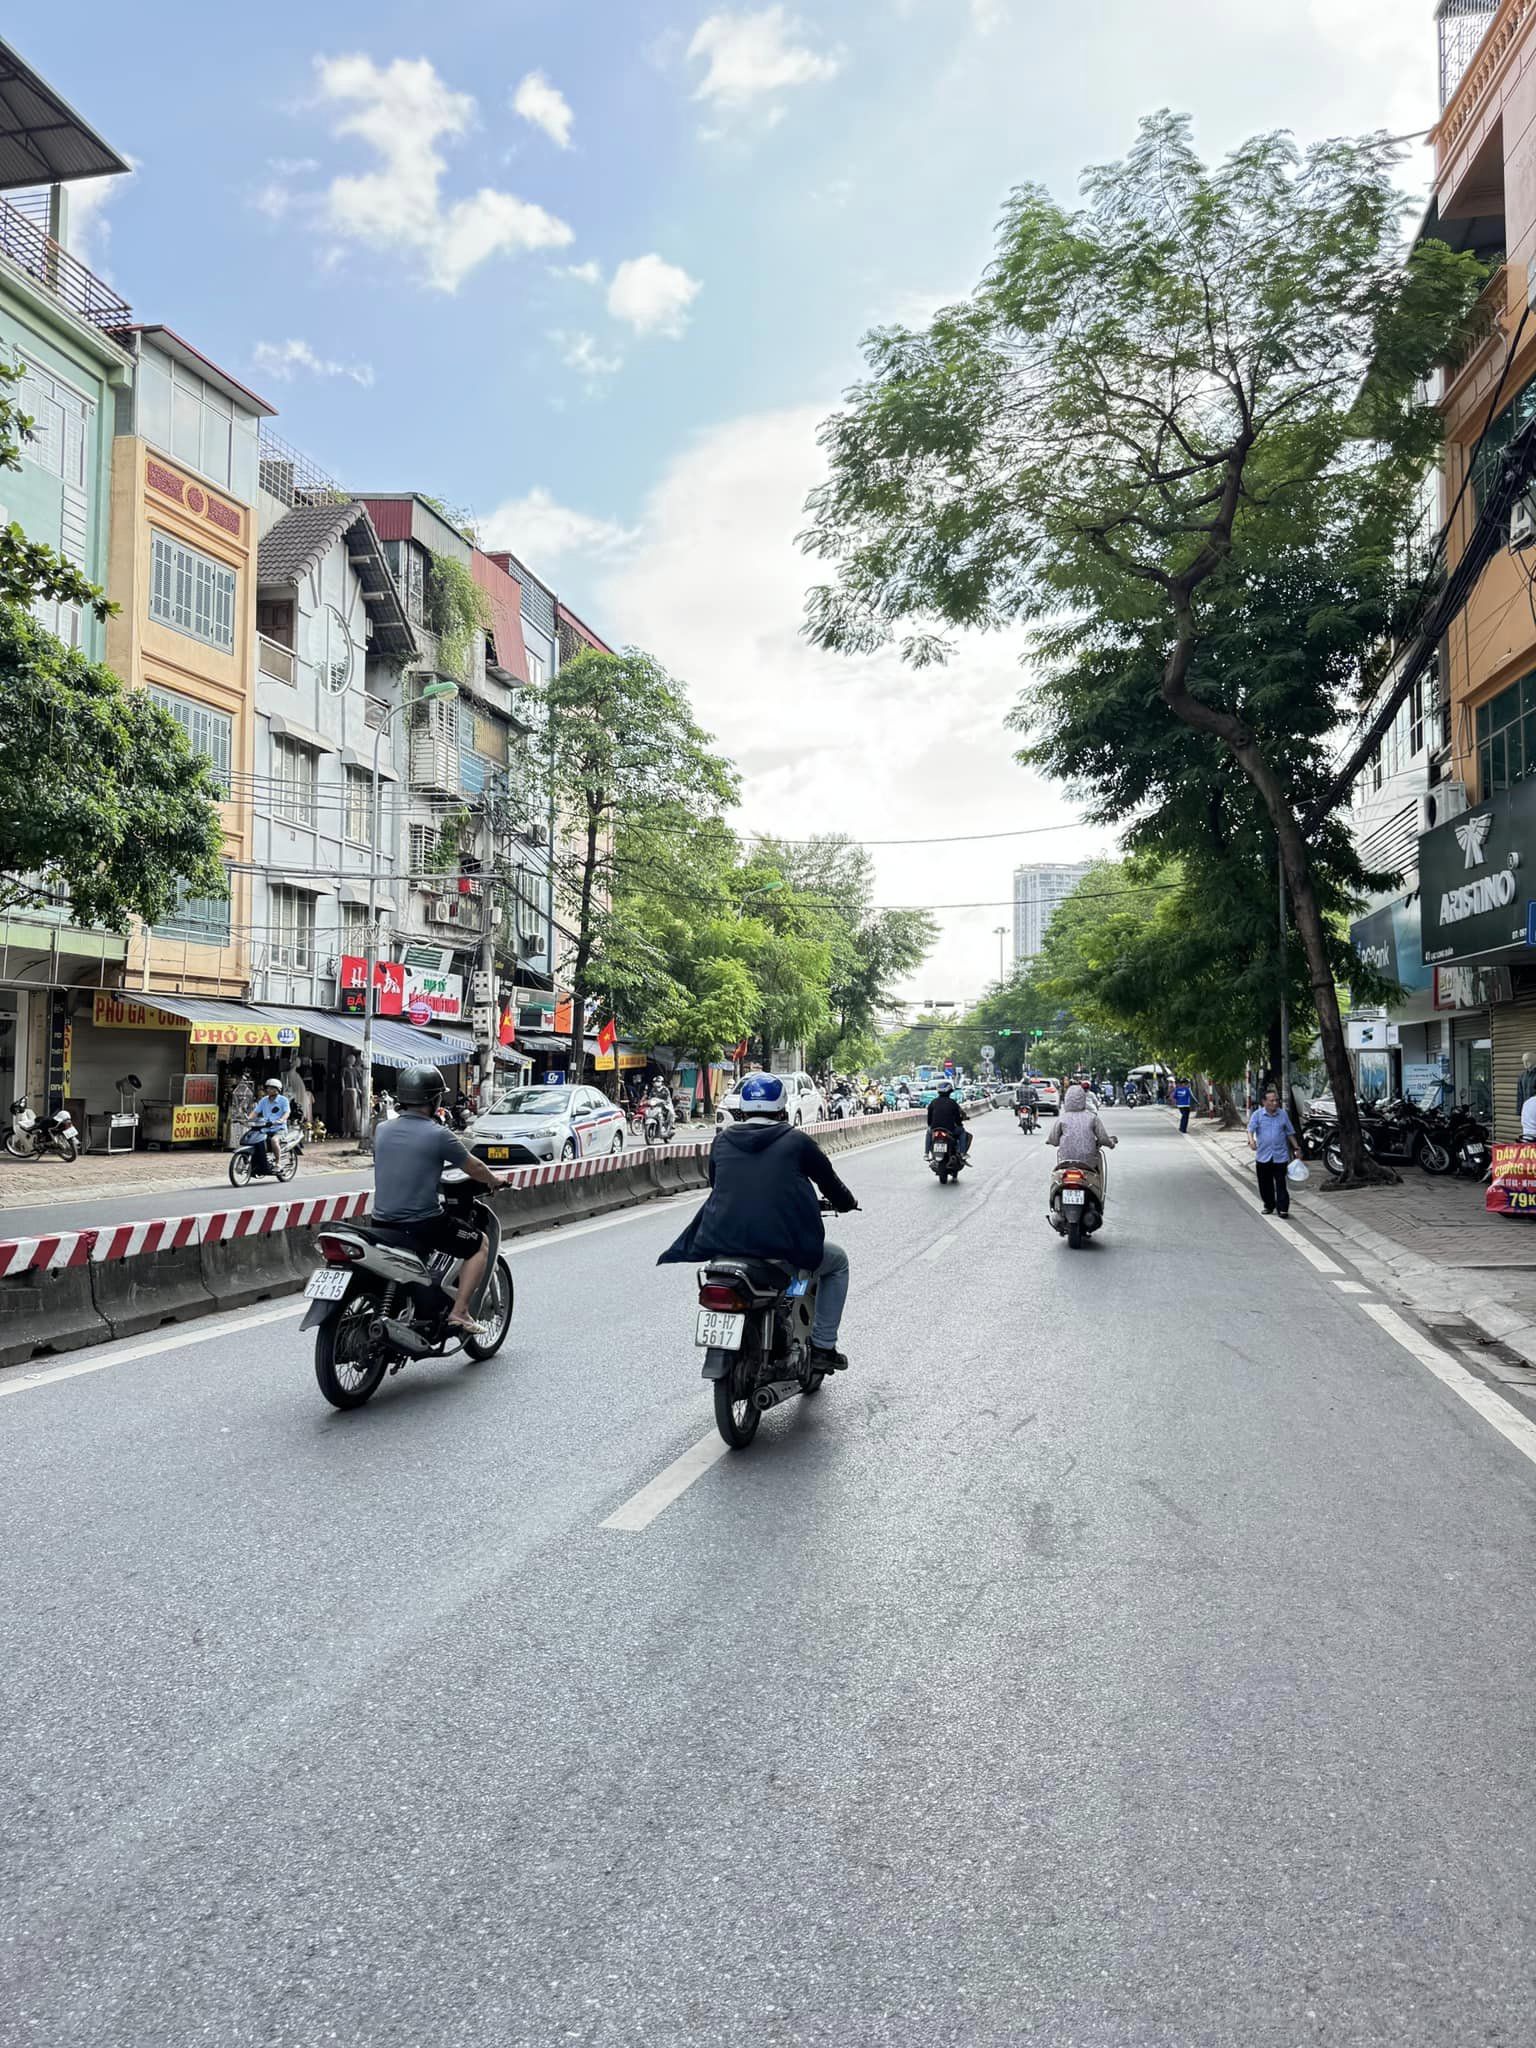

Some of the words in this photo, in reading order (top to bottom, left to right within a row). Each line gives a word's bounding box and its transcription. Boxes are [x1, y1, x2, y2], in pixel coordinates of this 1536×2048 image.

[1439, 870, 1515, 926] ARISTINO
[193, 1025, 237, 1043] PHỞ
[244, 1027, 273, 1044] GÀ
[176, 1108, 191, 1124] SỐT
[194, 1112, 216, 1123] VANG
[174, 1126, 191, 1138] CƠM
[194, 1126, 216, 1137] RANG
[315, 1271, 345, 1284] 29-P1
[703, 1313, 736, 1330] 30-H7
[702, 1329, 734, 1345] 5617
